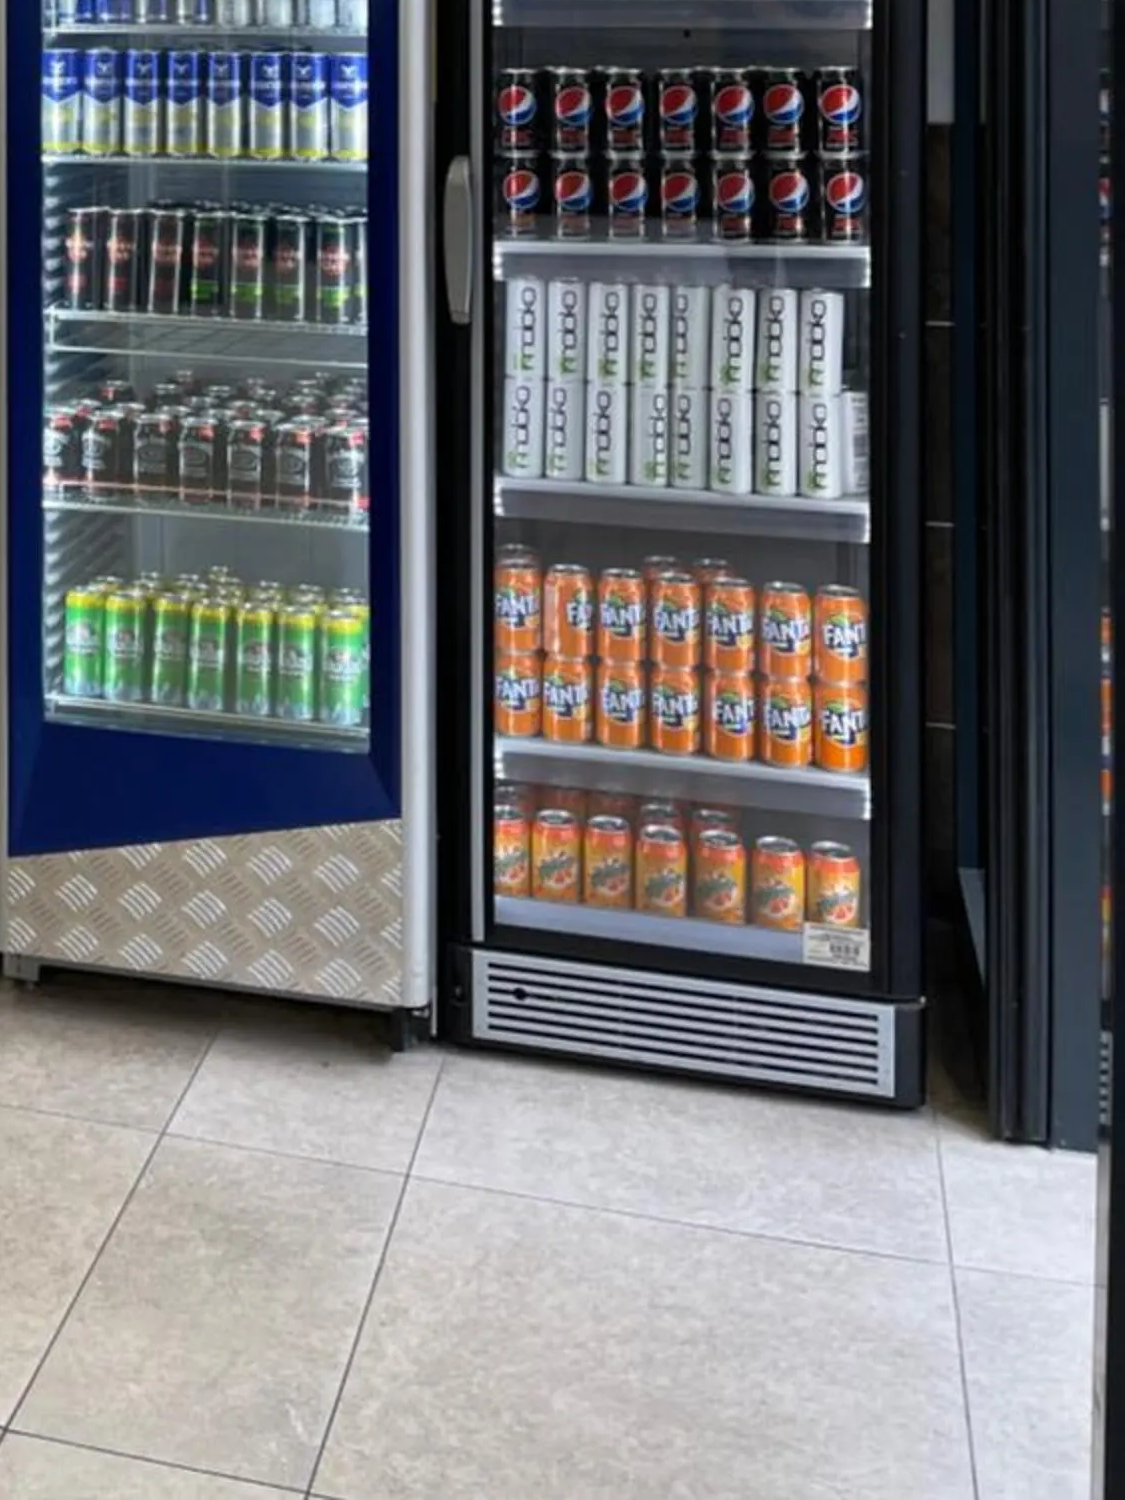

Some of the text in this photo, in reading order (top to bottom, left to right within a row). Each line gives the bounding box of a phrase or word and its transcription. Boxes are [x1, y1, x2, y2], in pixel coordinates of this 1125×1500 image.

[495, 592, 539, 619] FANT
[600, 603, 643, 629] FANT
[655, 608, 700, 634] FANT
[763, 615, 810, 643] FANT
[822, 621, 866, 650] FANT
[495, 675, 540, 703] FANT
[543, 680, 588, 708] FANT
[602, 686, 644, 713] FANT
[653, 690, 699, 717] FANT
[713, 699, 754, 727] FANT
[763, 703, 811, 730] FANT
[822, 708, 867, 737] FANT
